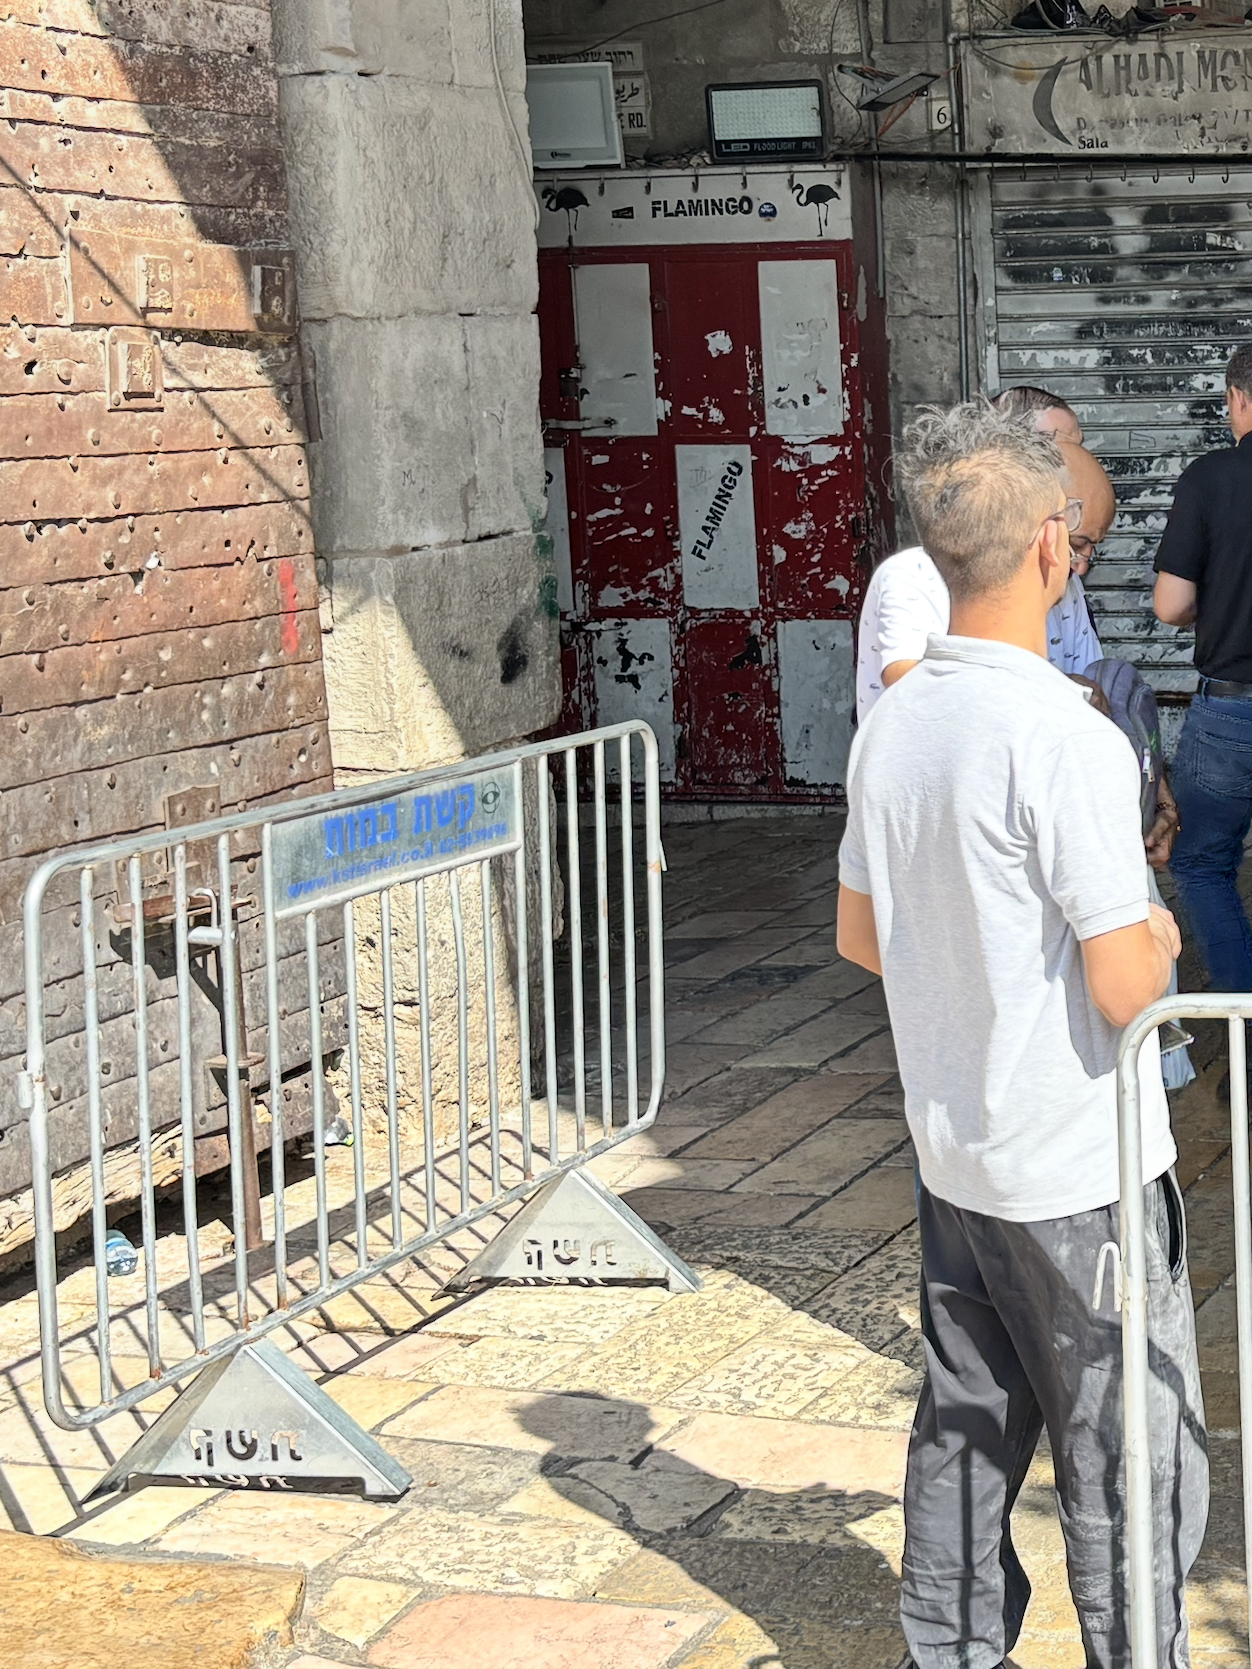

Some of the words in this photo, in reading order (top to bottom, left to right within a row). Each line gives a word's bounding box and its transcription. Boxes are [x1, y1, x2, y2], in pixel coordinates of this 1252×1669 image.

[628, 112, 647, 129] RD.
[937, 105, 947, 125] 6
[721, 143, 750, 152] LED
[651, 195, 754, 218] FLAMINGO
[690, 460, 743, 561] FLAMINGO
[413, 783, 475, 836] קשת
[324, 802, 398, 860] במות
